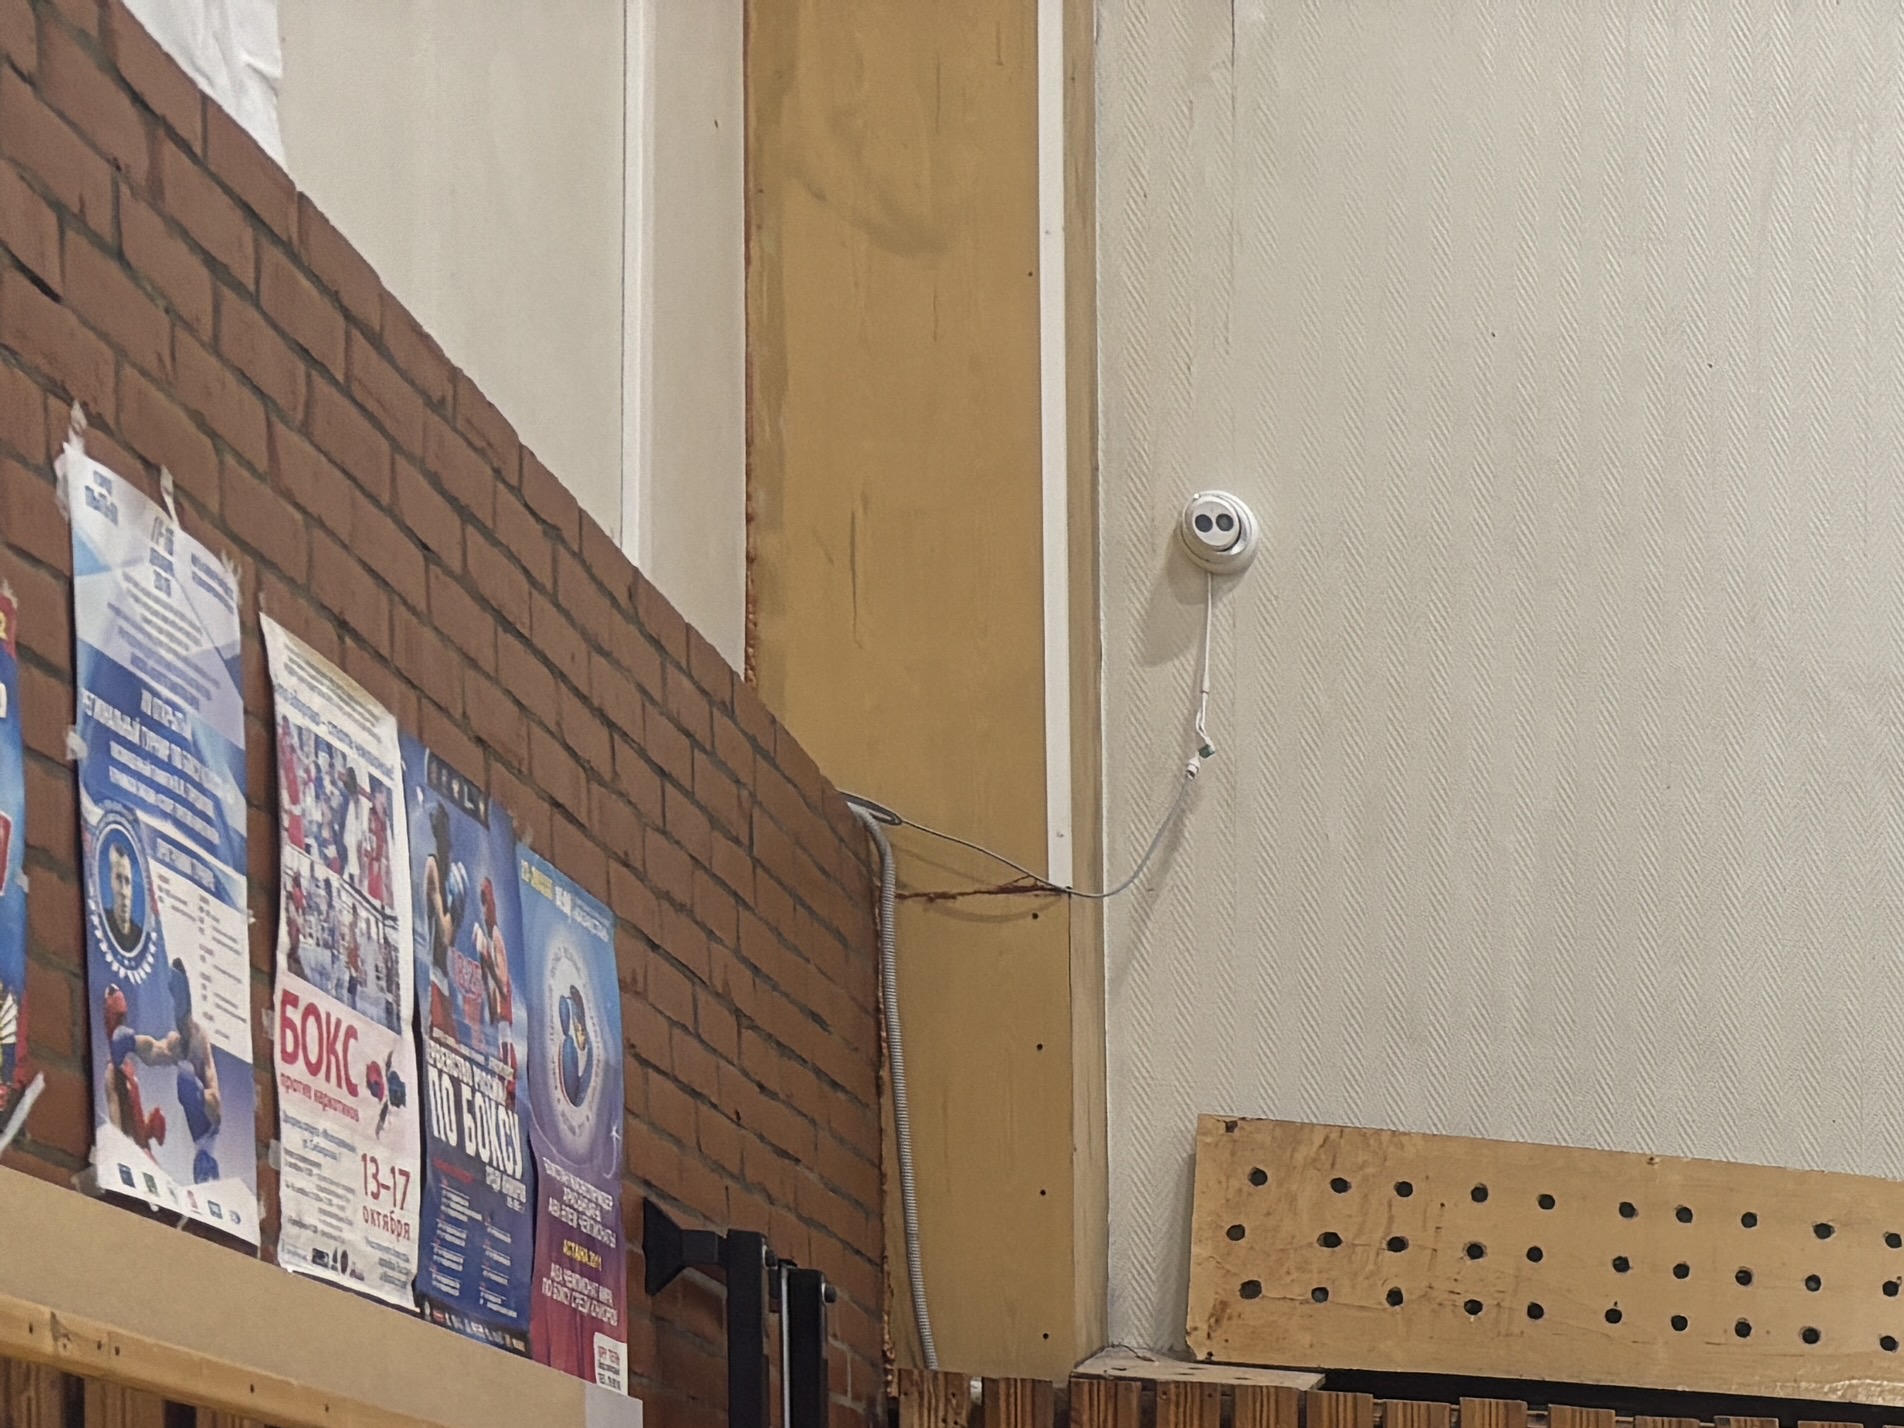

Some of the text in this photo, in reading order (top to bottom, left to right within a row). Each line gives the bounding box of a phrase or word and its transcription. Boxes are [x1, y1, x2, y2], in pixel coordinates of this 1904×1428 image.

[281, 988, 359, 1104] БОКС
[428, 1064, 457, 1147] ПО
[461, 1082, 523, 1179] БОКСУ
[362, 1205, 412, 1243] октября
